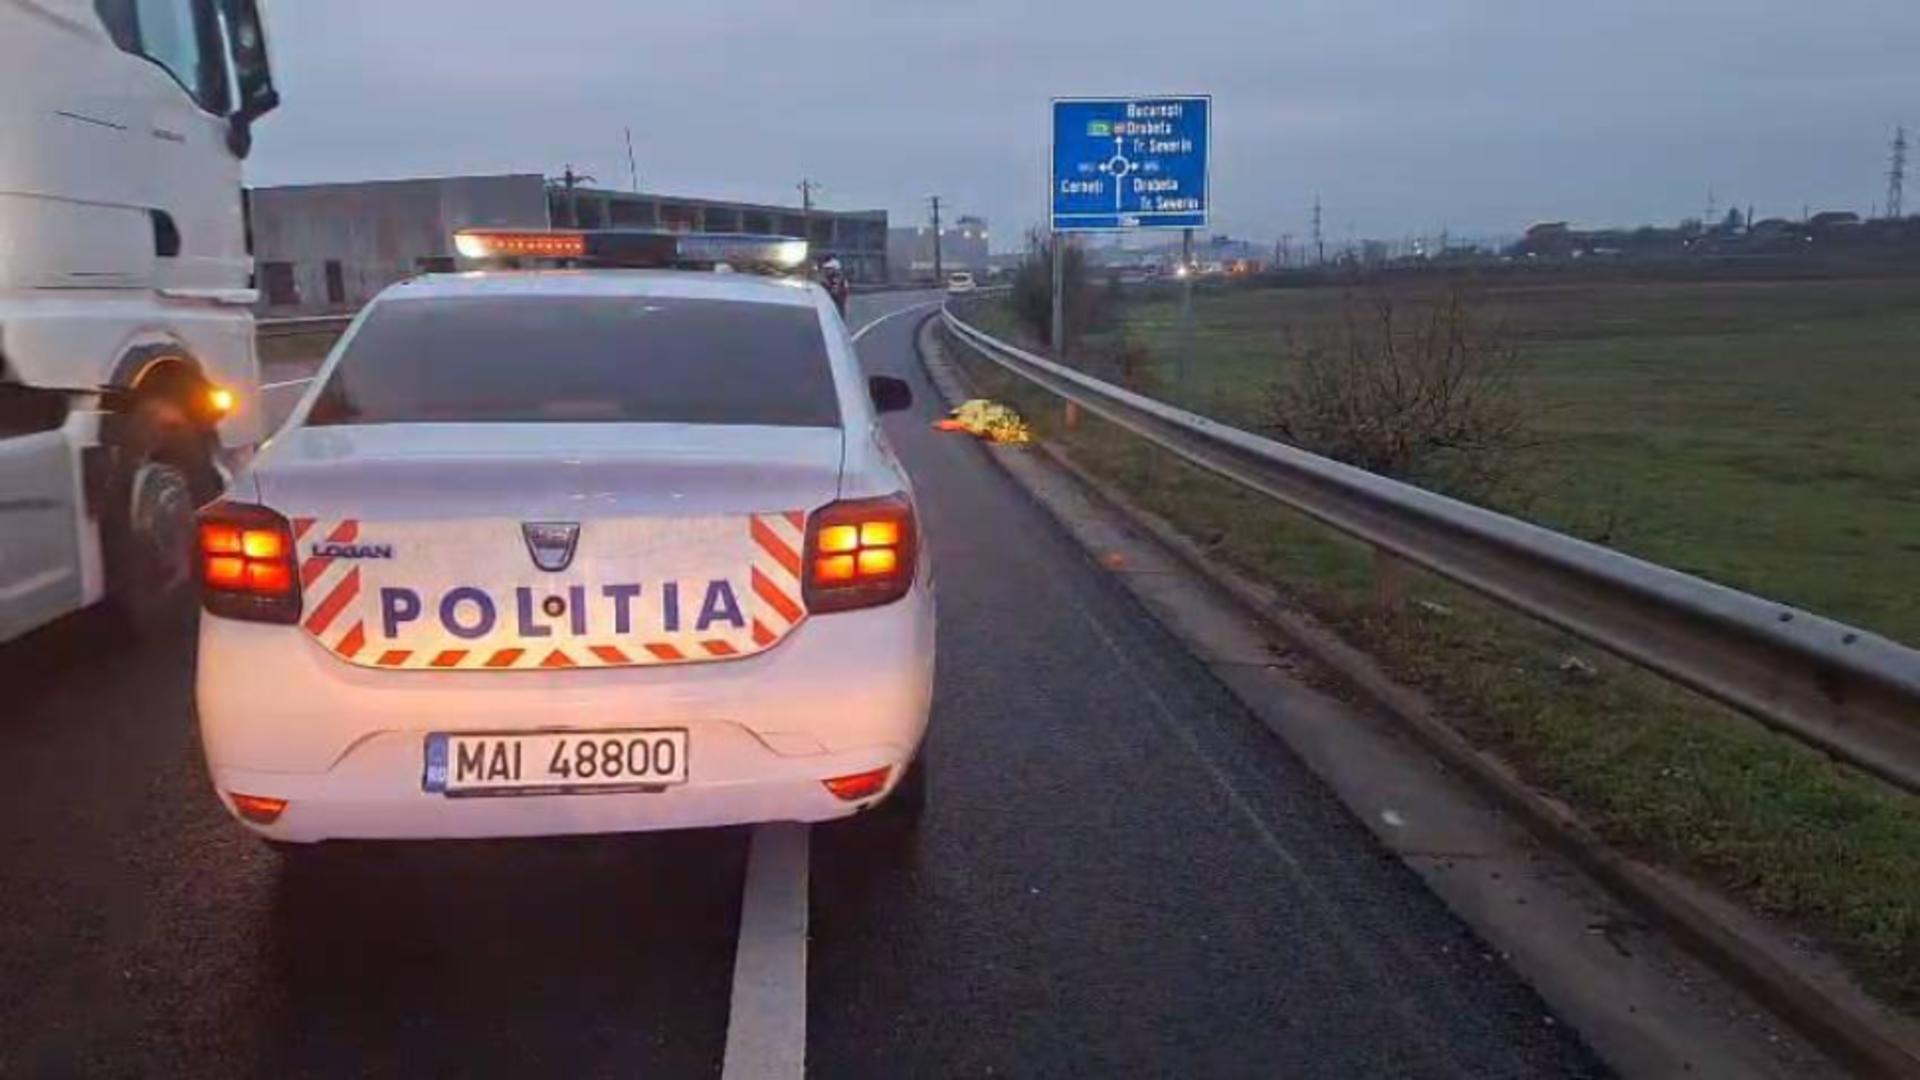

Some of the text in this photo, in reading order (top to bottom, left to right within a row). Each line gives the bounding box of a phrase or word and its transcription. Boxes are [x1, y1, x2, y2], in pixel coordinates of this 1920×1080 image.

[312, 543, 392, 560] LOGAN
[380, 580, 745, 639] POLITIA
[456, 738, 676, 782] MAI 48800
